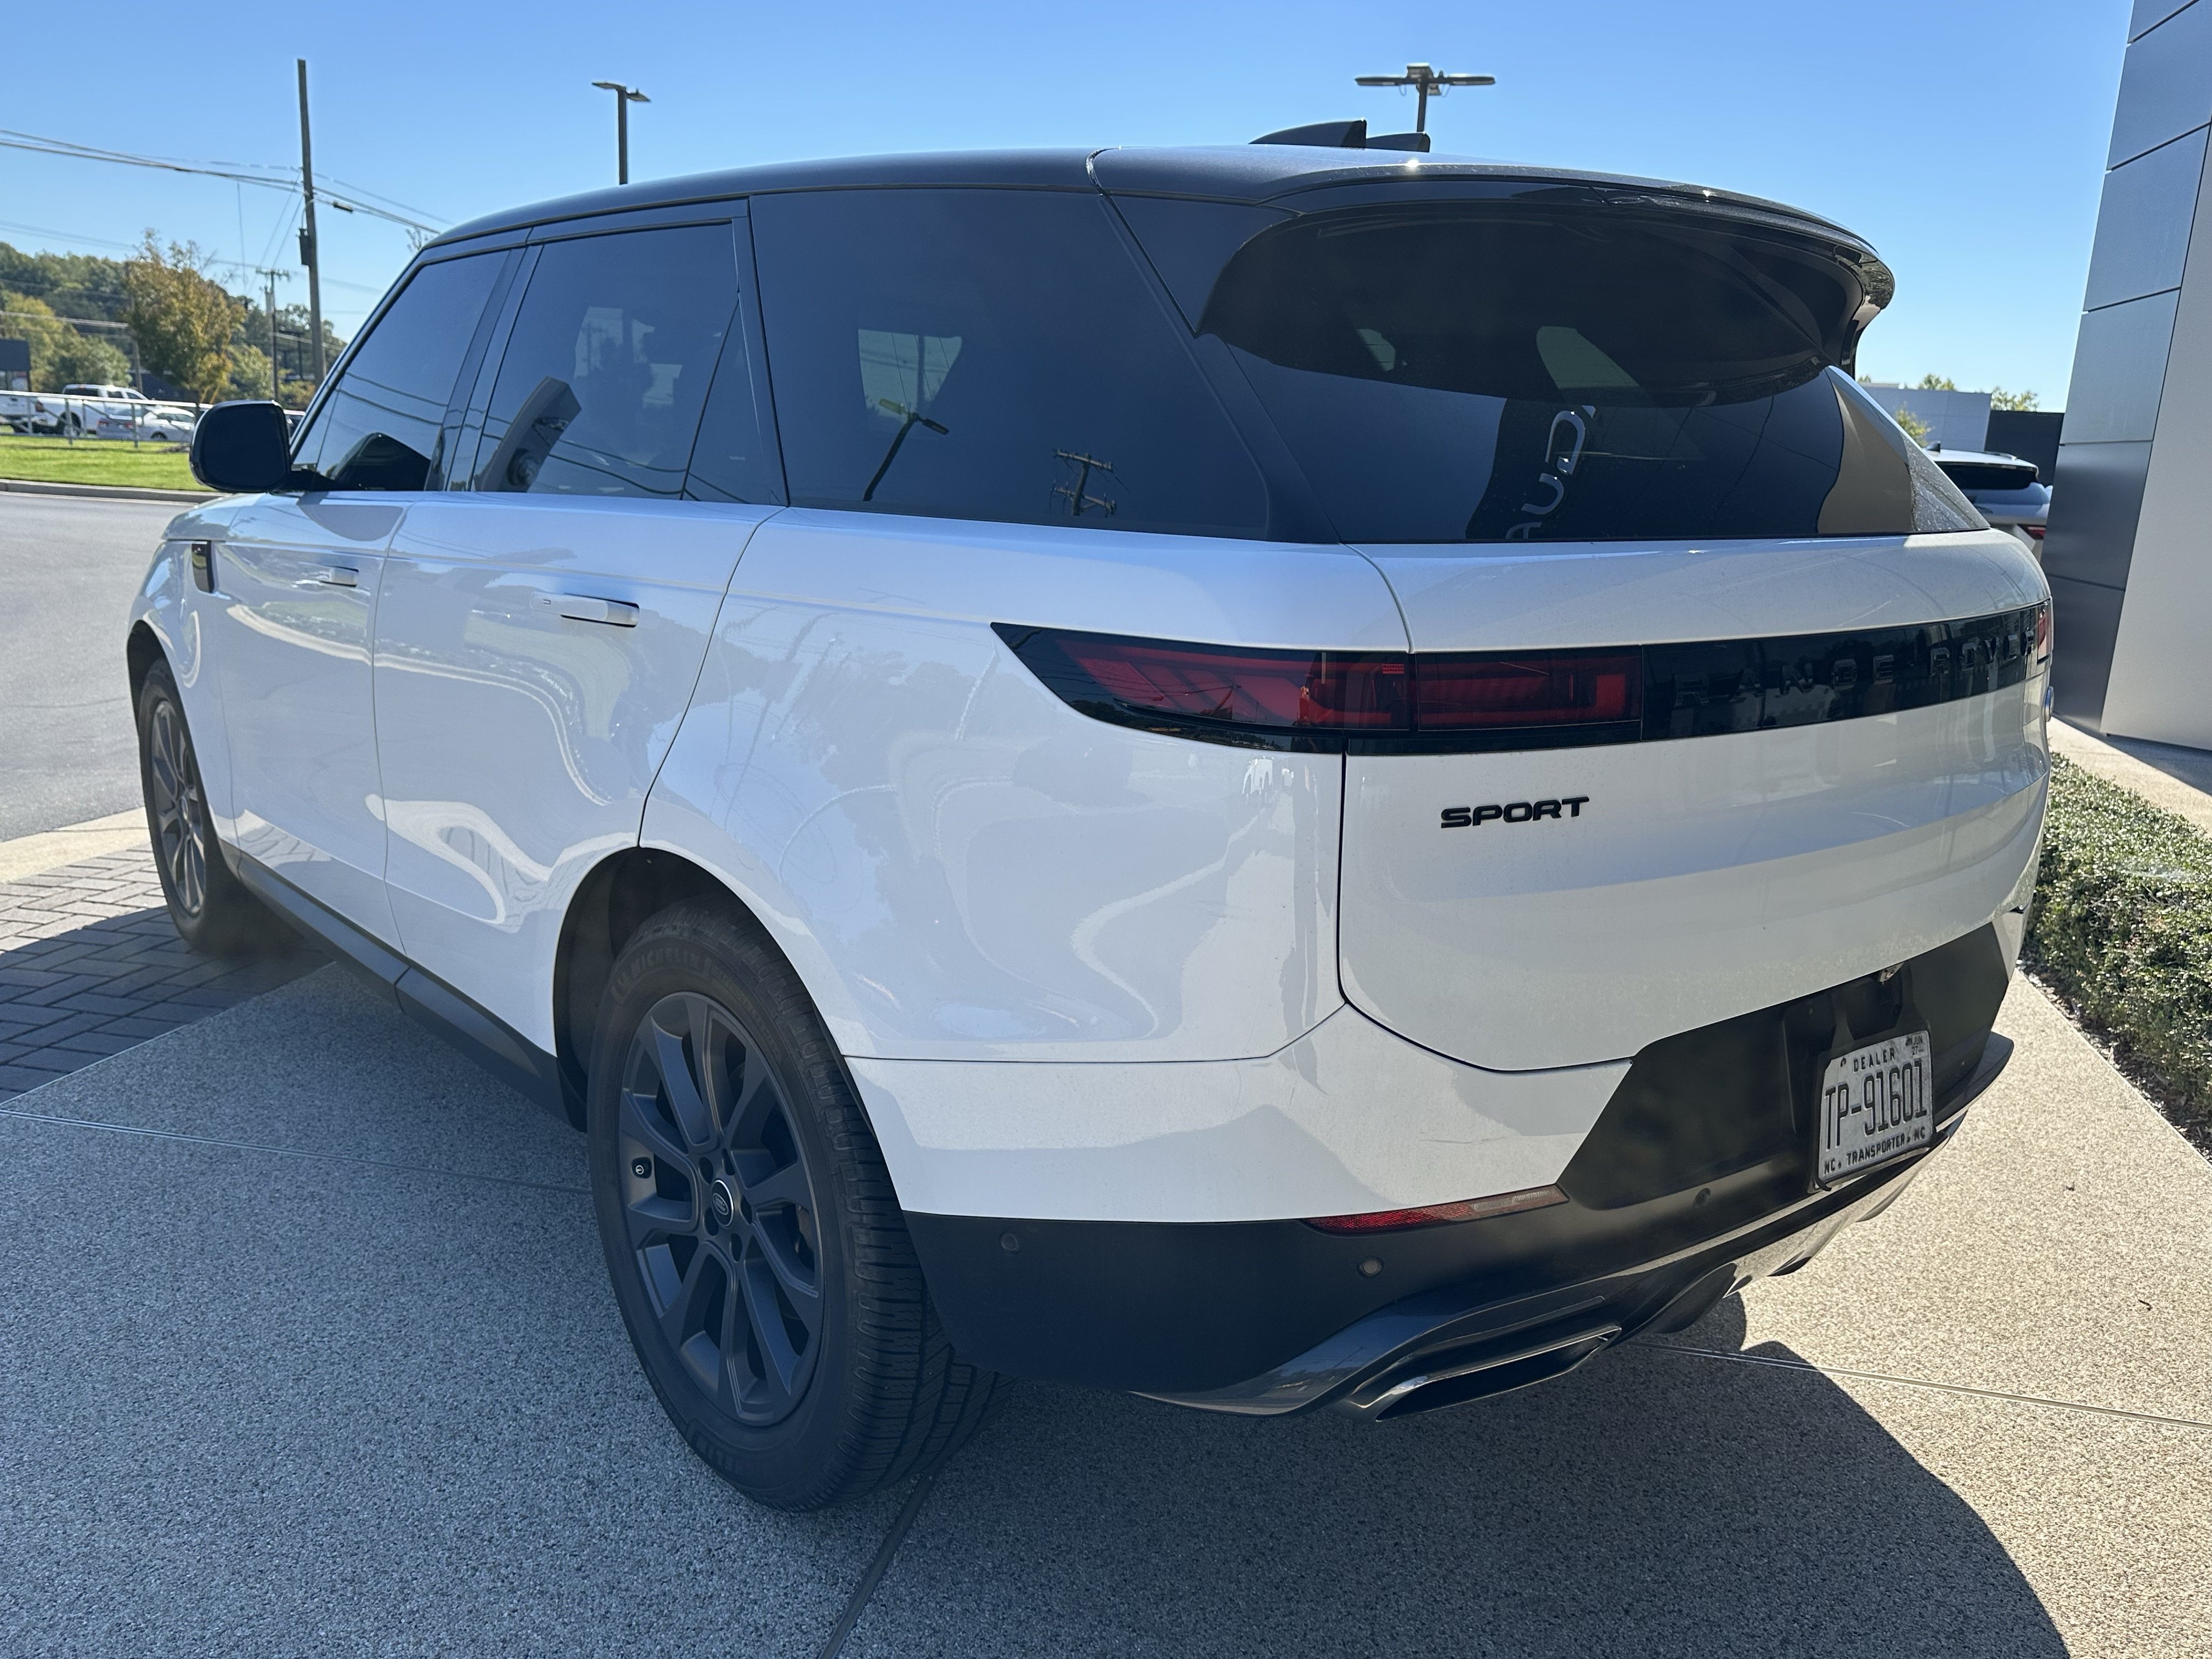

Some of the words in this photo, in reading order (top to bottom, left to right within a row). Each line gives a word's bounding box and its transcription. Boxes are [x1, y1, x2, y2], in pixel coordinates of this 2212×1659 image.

[1674, 654, 1894, 707] RANGE
[1441, 797, 1589, 828] SPORT
[1854, 1047, 1895, 1072] DEALER
[1825, 1059, 1927, 1150] TP-91601
[1824, 1159, 1836, 1175] NC
[1847, 1133, 1905, 1166] TRANSPORTER
[1914, 1126, 1925, 1141] NC
